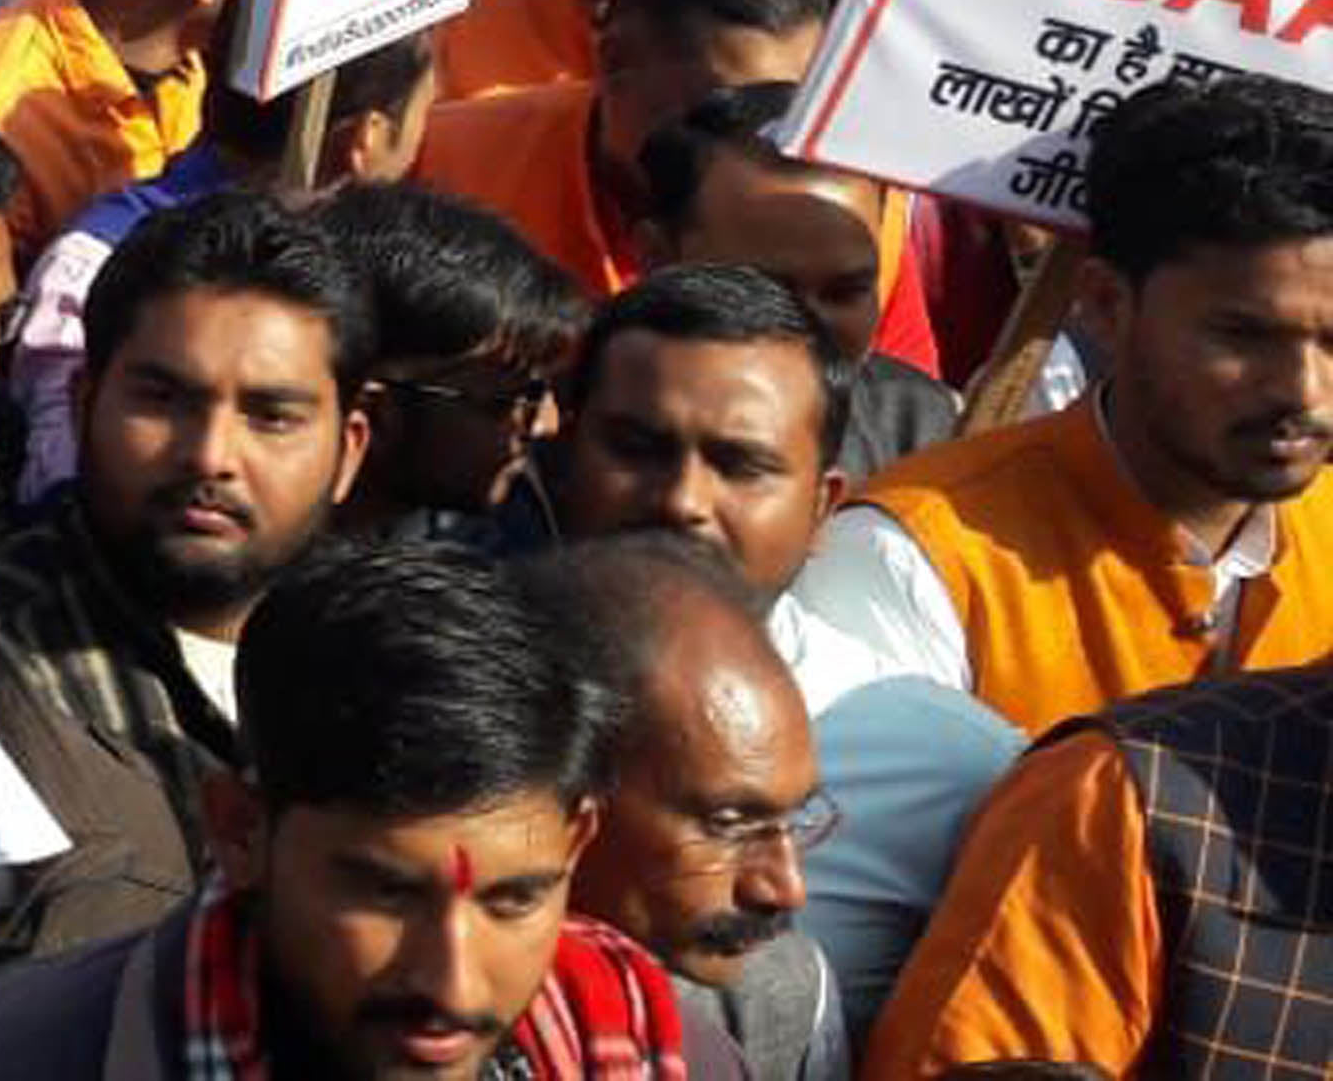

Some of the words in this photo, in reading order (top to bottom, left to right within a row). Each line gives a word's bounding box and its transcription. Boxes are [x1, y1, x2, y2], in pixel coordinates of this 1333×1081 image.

[1036, 17, 1115, 71] का
[1115, 23, 1163, 85] है
[929, 62, 1076, 132] लाखों
